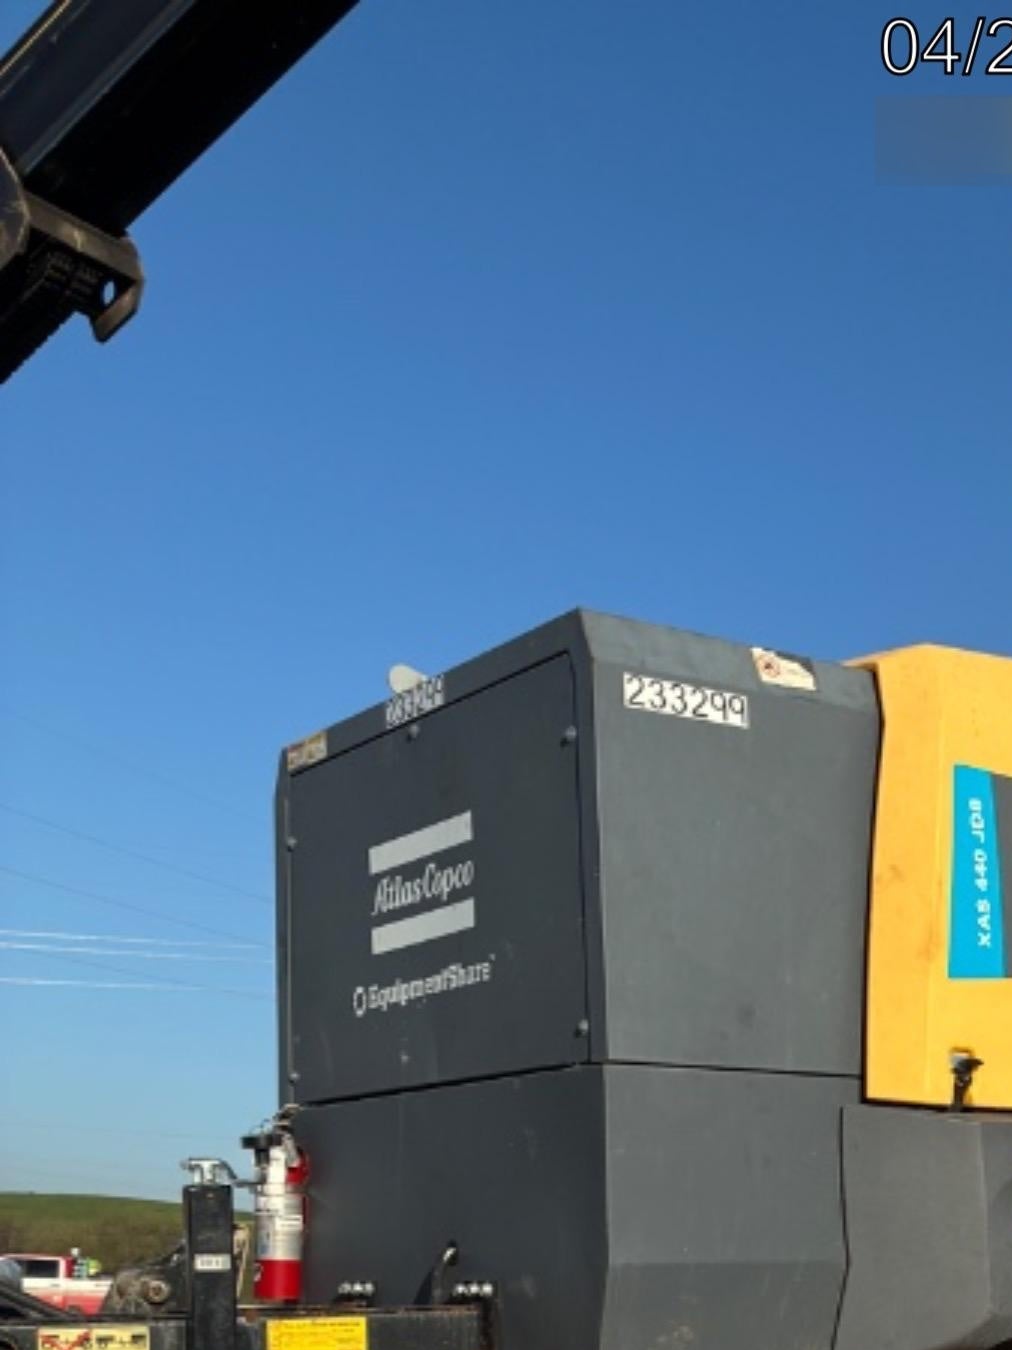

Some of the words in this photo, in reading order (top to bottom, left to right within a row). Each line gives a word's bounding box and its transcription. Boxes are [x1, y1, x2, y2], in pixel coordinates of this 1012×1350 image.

[624, 671, 747, 725] 233299
[973, 848, 988, 891] 440
[976, 898, 992, 948] XAS
[368, 961, 491, 1012] EquipmentShare
